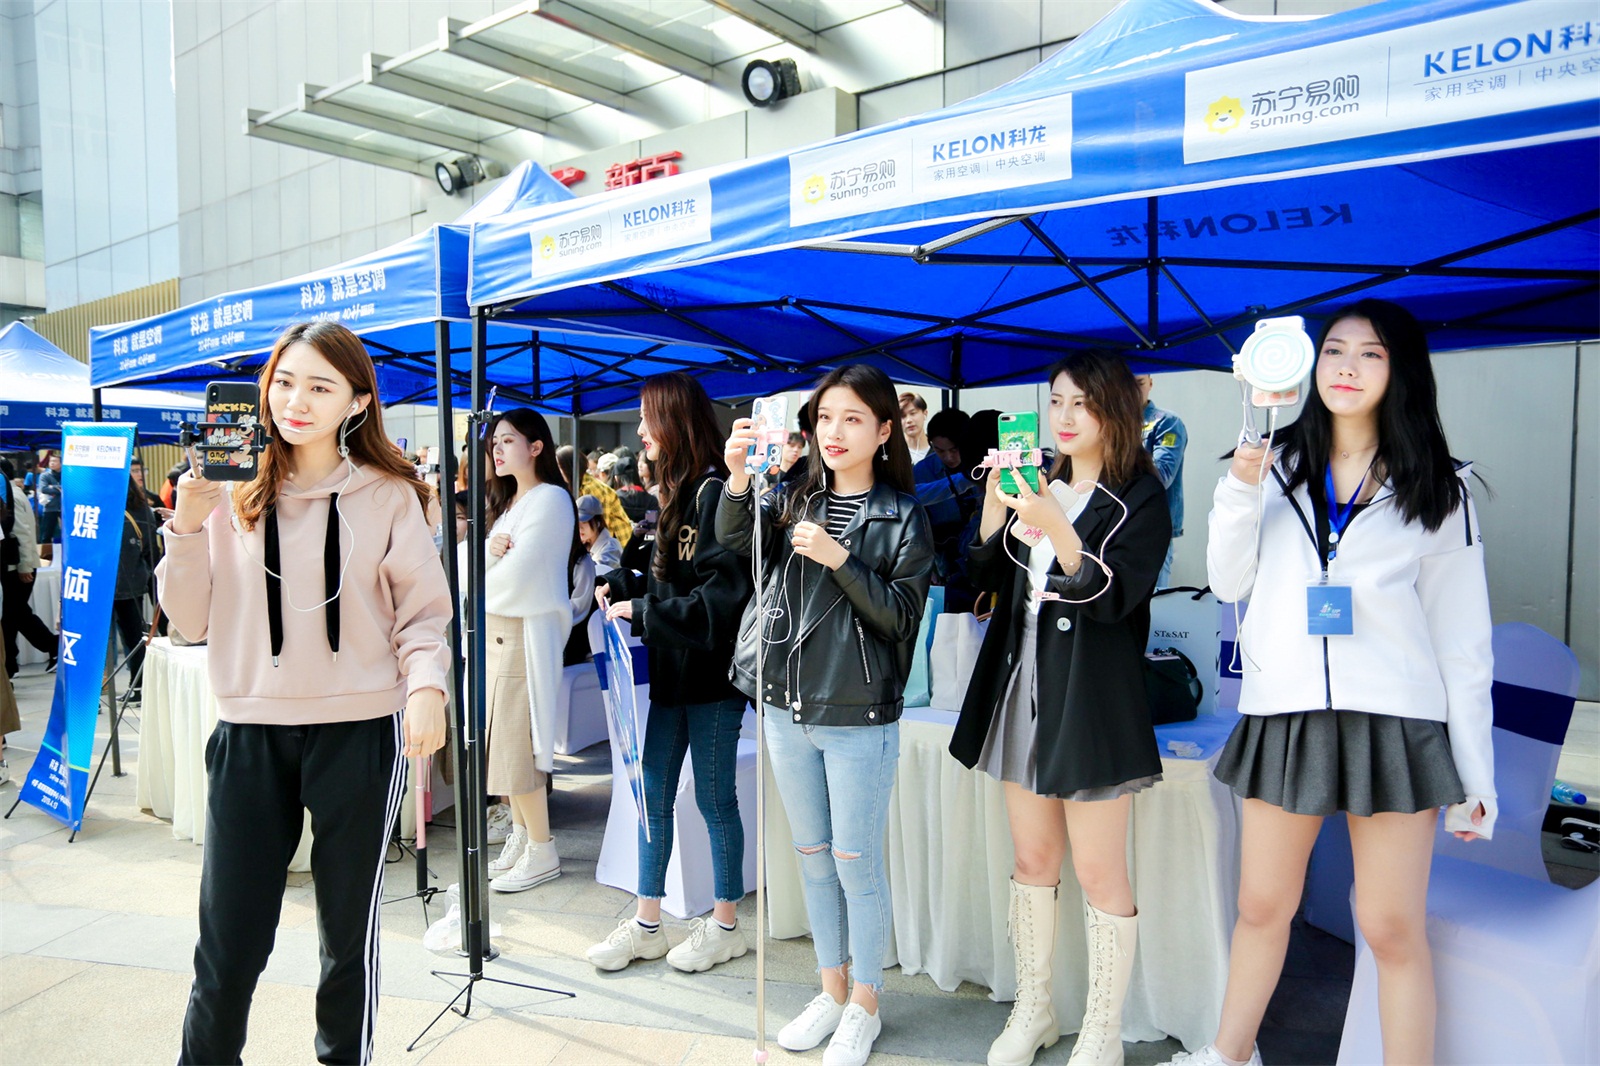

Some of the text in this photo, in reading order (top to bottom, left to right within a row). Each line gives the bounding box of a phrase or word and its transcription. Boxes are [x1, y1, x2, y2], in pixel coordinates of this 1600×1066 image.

[1423, 21, 1600, 78] KELON科
[1250, 74, 1360, 117] 苏宁易购
[1424, 74, 1506, 103] 家用空调
[1249, 102, 1360, 130] suning.com
[829, 159, 896, 191] 苏宁易购
[933, 150, 1046, 181] 家用空调 中央空调
[829, 179, 897, 202] suning.com
[558, 224, 602, 249] 苏宁易购
[558, 240, 602, 258] suning.com
[300, 268, 386, 310] 科龙 就是空调
[208, 403, 255, 413] MICKEY
[1153, 630, 1190, 639] ST&SAT
